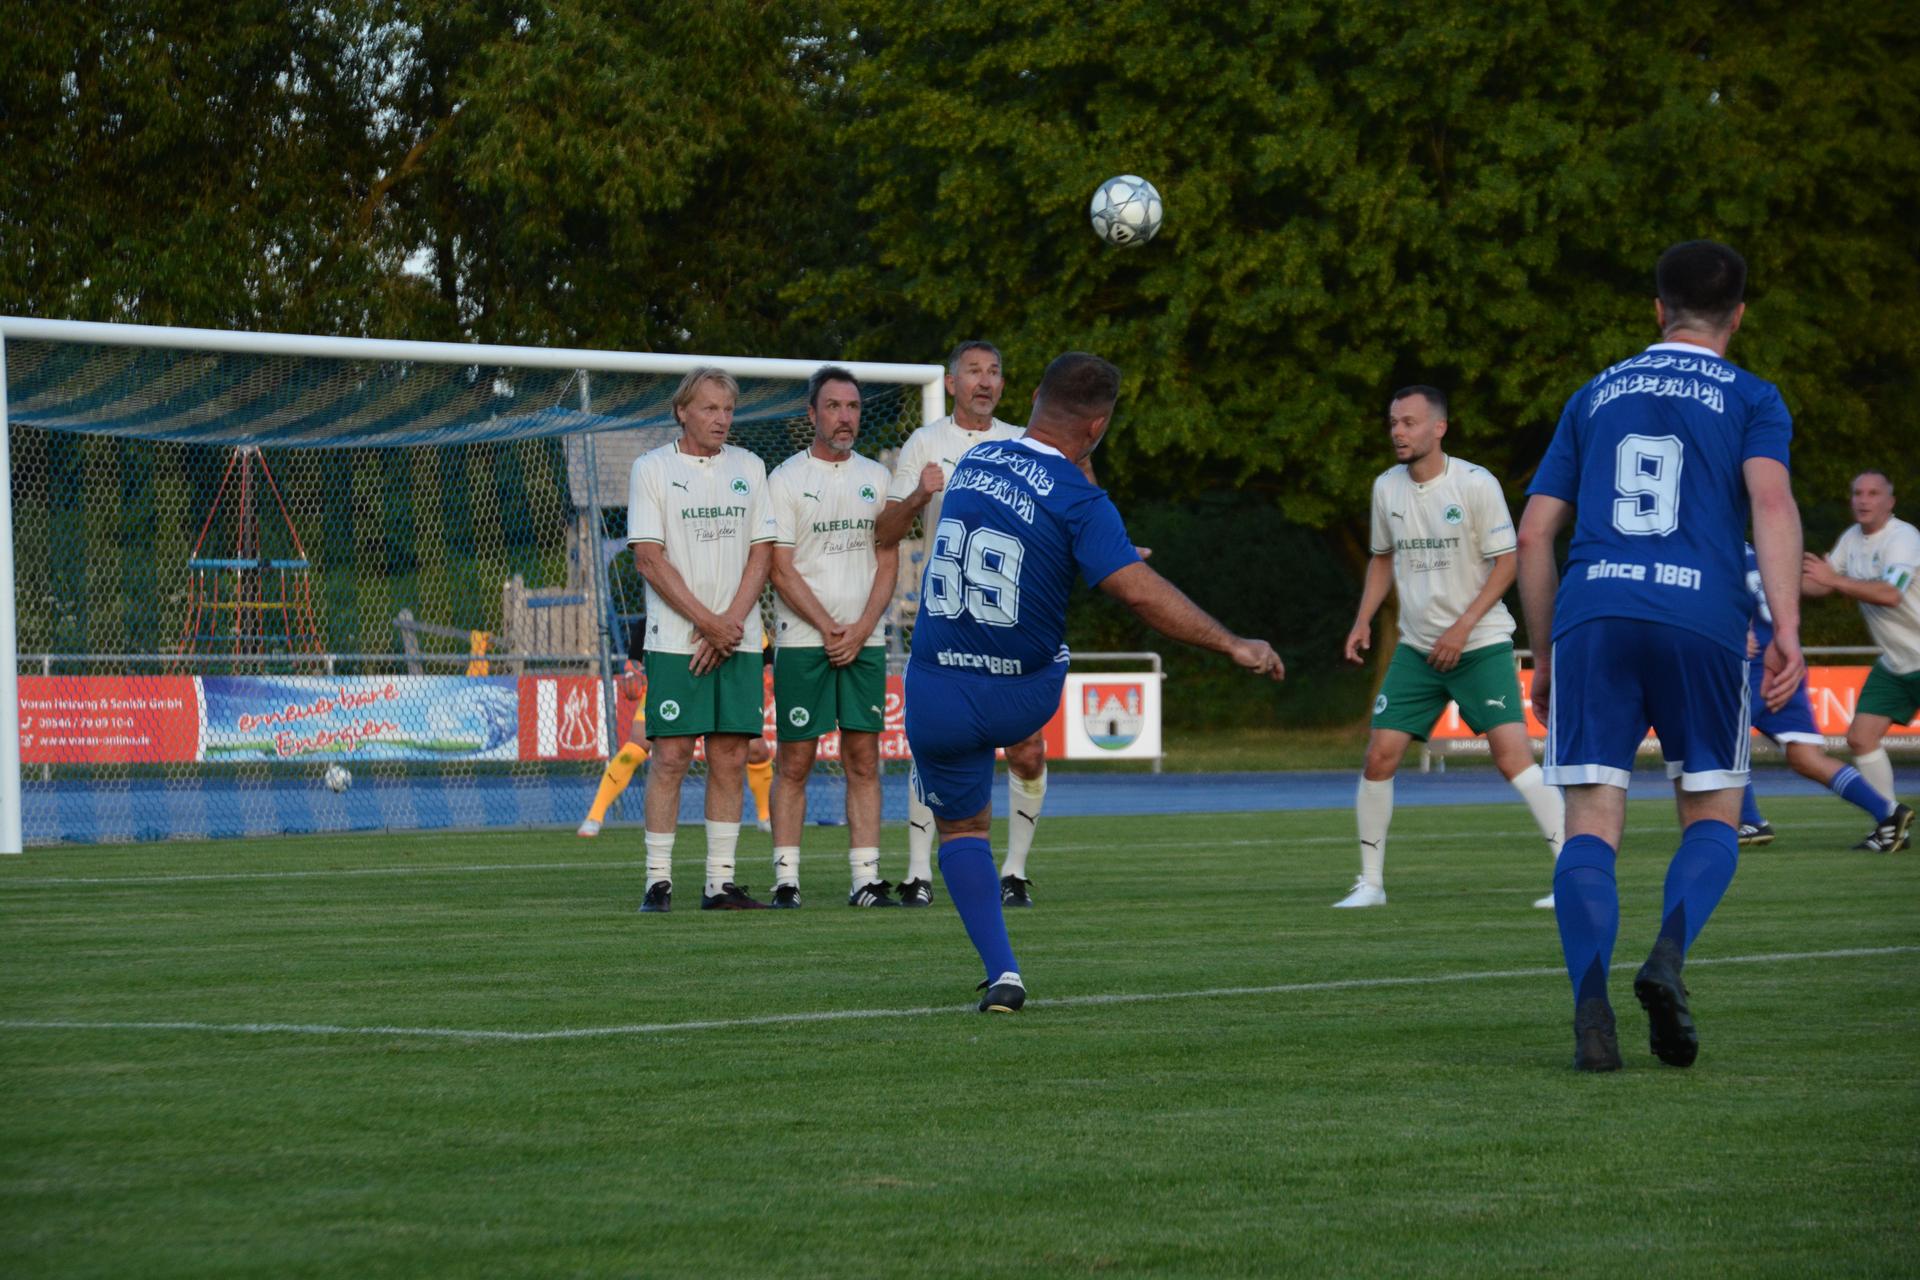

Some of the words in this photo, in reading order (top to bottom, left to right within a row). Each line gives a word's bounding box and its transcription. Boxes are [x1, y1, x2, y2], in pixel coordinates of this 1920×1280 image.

[1612, 433, 1684, 537] 9
[681, 505, 747, 519] KLEEBLATT
[813, 518, 875, 533] KLEEBLATT
[1397, 537, 1460, 550] KLEEBLATT
[925, 517, 1025, 627] 69
[1586, 559, 1647, 580] since
[937, 648, 984, 668] since
